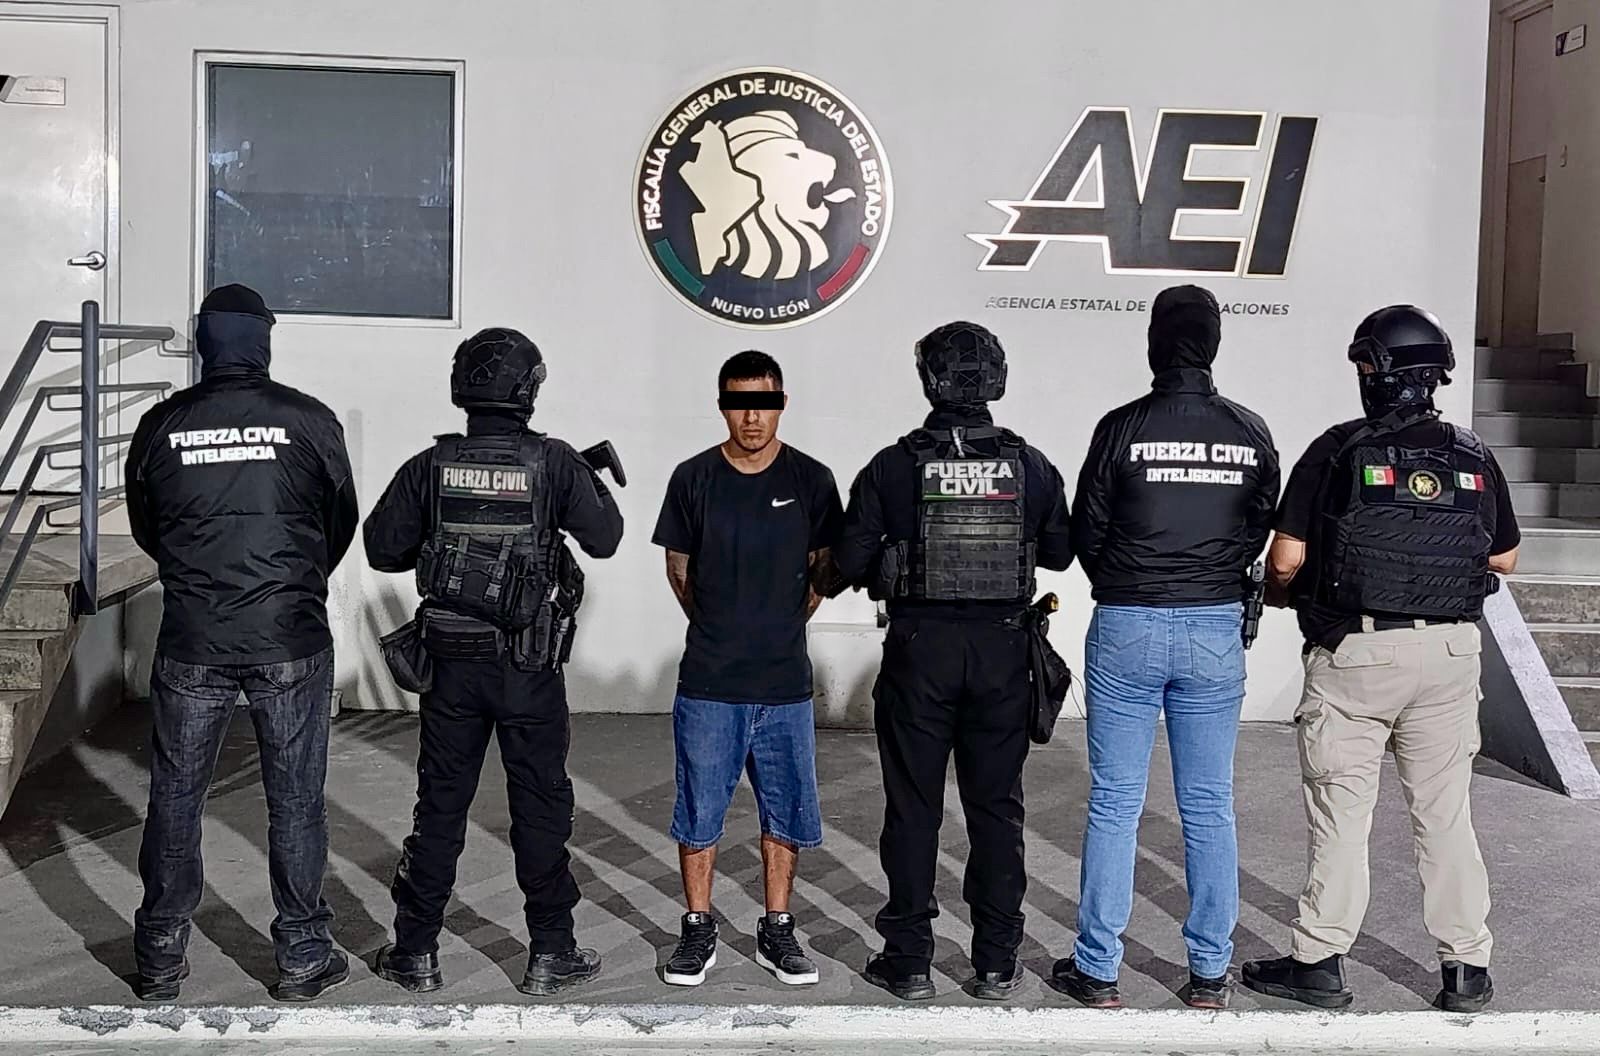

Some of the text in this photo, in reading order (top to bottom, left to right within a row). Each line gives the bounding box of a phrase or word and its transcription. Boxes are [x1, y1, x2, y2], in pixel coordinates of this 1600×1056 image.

[643, 78, 882, 236] FISCALÍA GENERAL DE JUSTICIA DEL ESTADO
[965, 106, 1319, 280] AEI
[711, 296, 810, 319] NUEVO LEÓN
[985, 297, 1056, 309] AGENCIA
[1060, 298, 1122, 311] ESTATAL
[1126, 300, 1147, 312] DE
[168, 427, 291, 449] FUERZA CIVIL
[181, 446, 276, 465] INTELIGENCIA
[1130, 442, 1258, 466] FUERZA CIVIL
[443, 467, 528, 491] FUERZA CIVIL
[924, 462, 1013, 479] FUERZA
[1146, 468, 1243, 485] INTELIGENCIA
[940, 478, 999, 495] CIVIL
